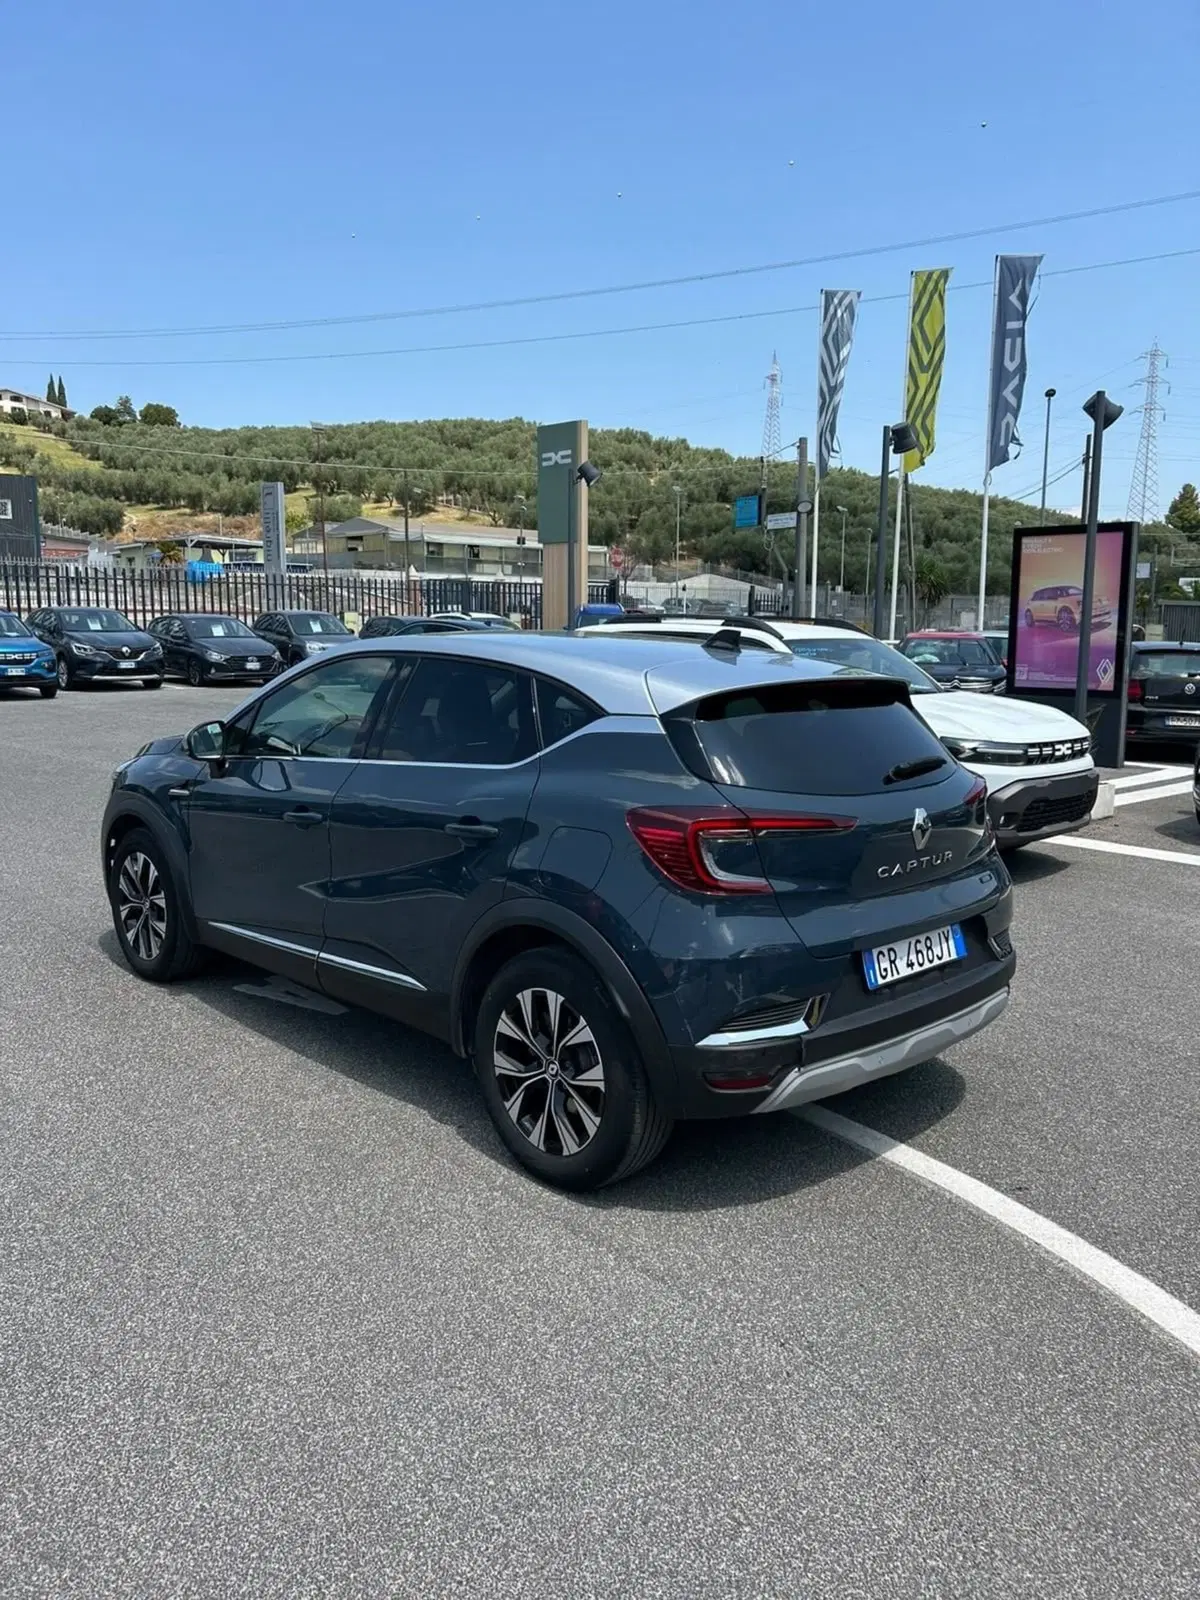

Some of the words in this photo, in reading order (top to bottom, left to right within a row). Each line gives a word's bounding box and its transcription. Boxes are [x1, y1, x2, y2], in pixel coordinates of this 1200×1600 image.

[877, 851, 953, 879] CAPTUR
[876, 946, 900, 980] GR
[905, 929, 953, 971] 468JY
